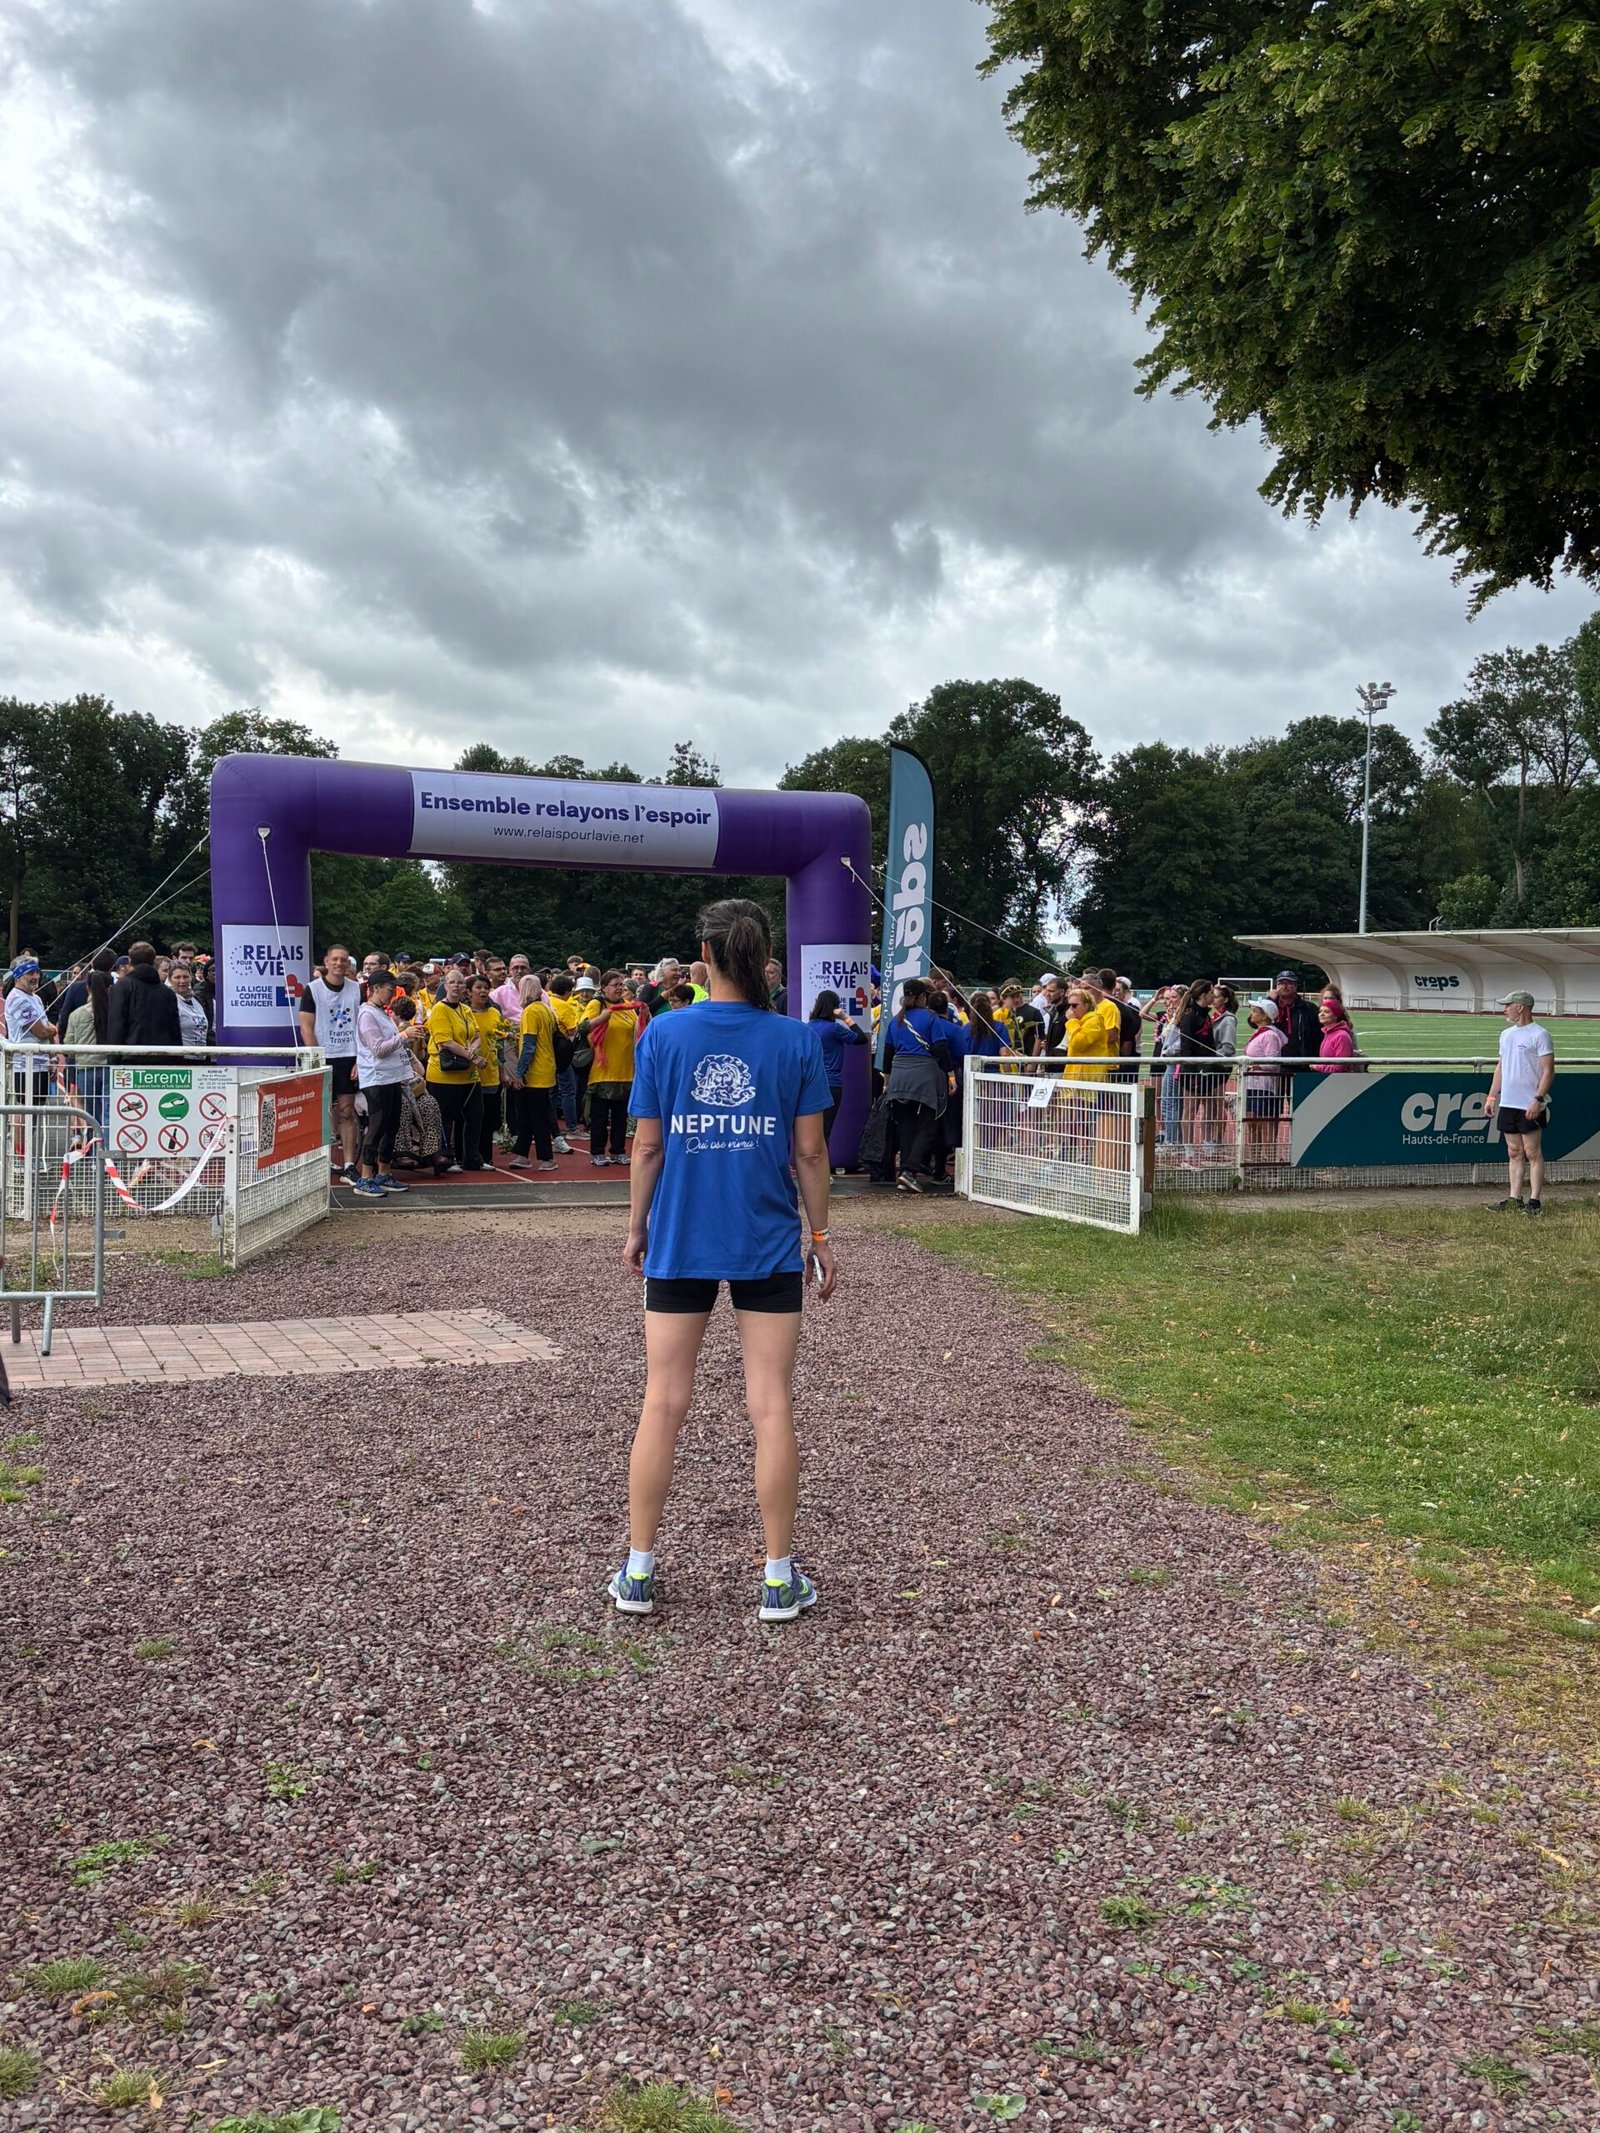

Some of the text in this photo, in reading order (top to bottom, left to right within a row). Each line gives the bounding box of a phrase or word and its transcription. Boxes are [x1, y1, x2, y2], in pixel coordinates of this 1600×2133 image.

[420, 791, 712, 828] Ensemble relayons l'espoir
[493, 825, 645, 844] www.relaispourlavie.net
[243, 945, 303, 960] RELAIS
[254, 961, 285, 975] VIE
[821, 961, 869, 975] RELAIS
[832, 975, 856, 989] VIE
[1414, 975, 1460, 991] creps
[135, 1070, 191, 1084] Terenvi
[670, 1114, 777, 1136] NEPTUNE
[1401, 1092, 1553, 1144] cre
[685, 1136, 709, 1154] Qui
[710, 1140, 726, 1149] ose
[1402, 1133, 1485, 1145] Hauts-de-France
